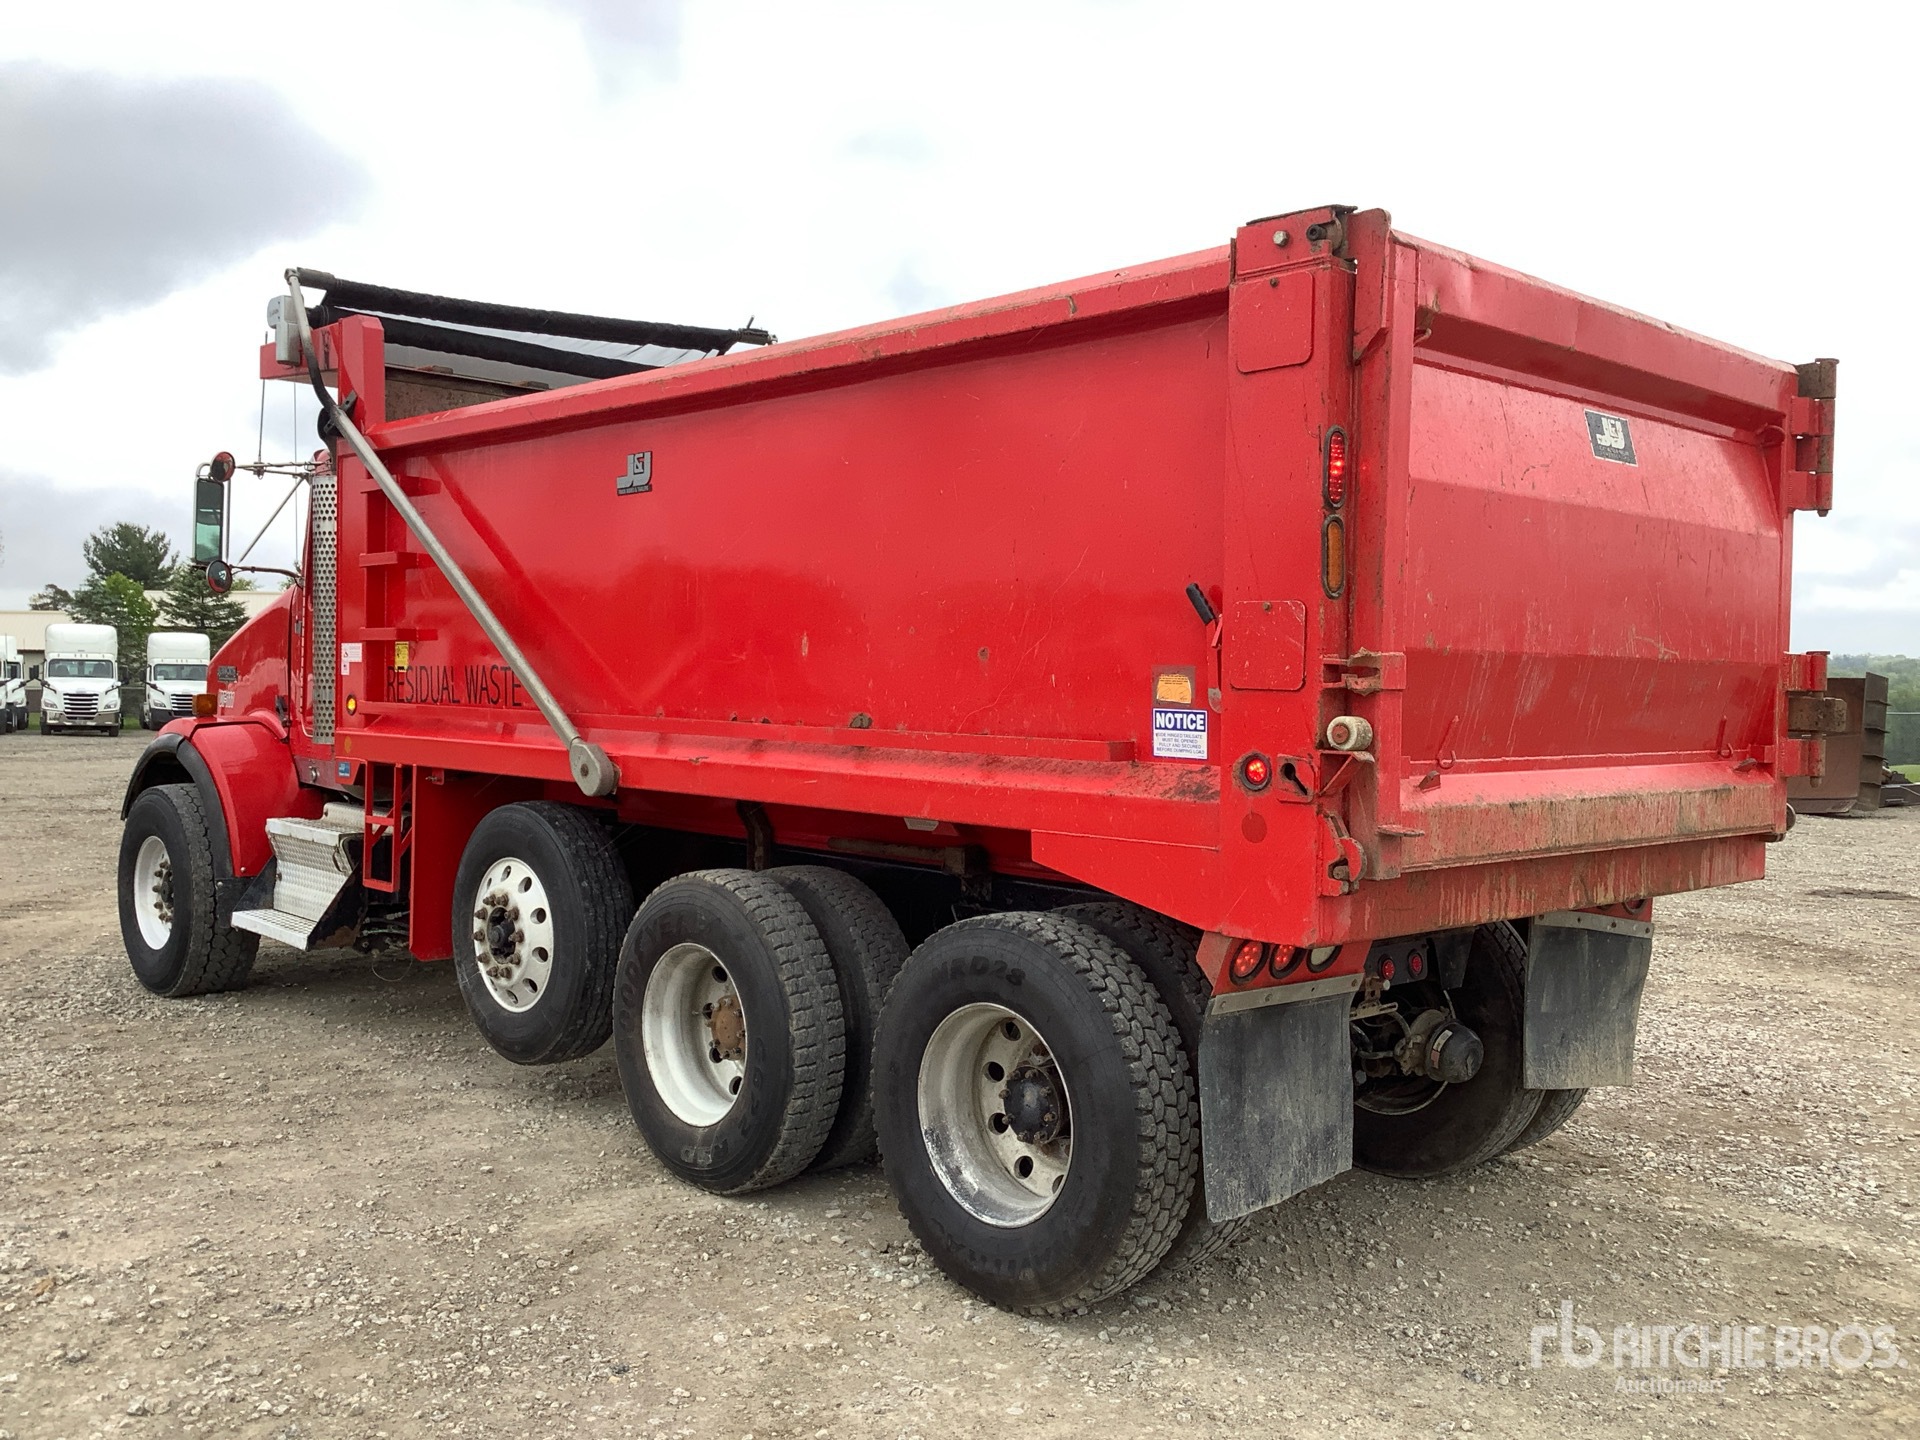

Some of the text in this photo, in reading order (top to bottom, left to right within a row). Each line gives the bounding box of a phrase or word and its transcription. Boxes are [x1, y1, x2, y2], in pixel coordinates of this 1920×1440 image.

[387, 665, 522, 707] RESIDUAL WASTE
[1156, 712, 1205, 730] NOTICE
